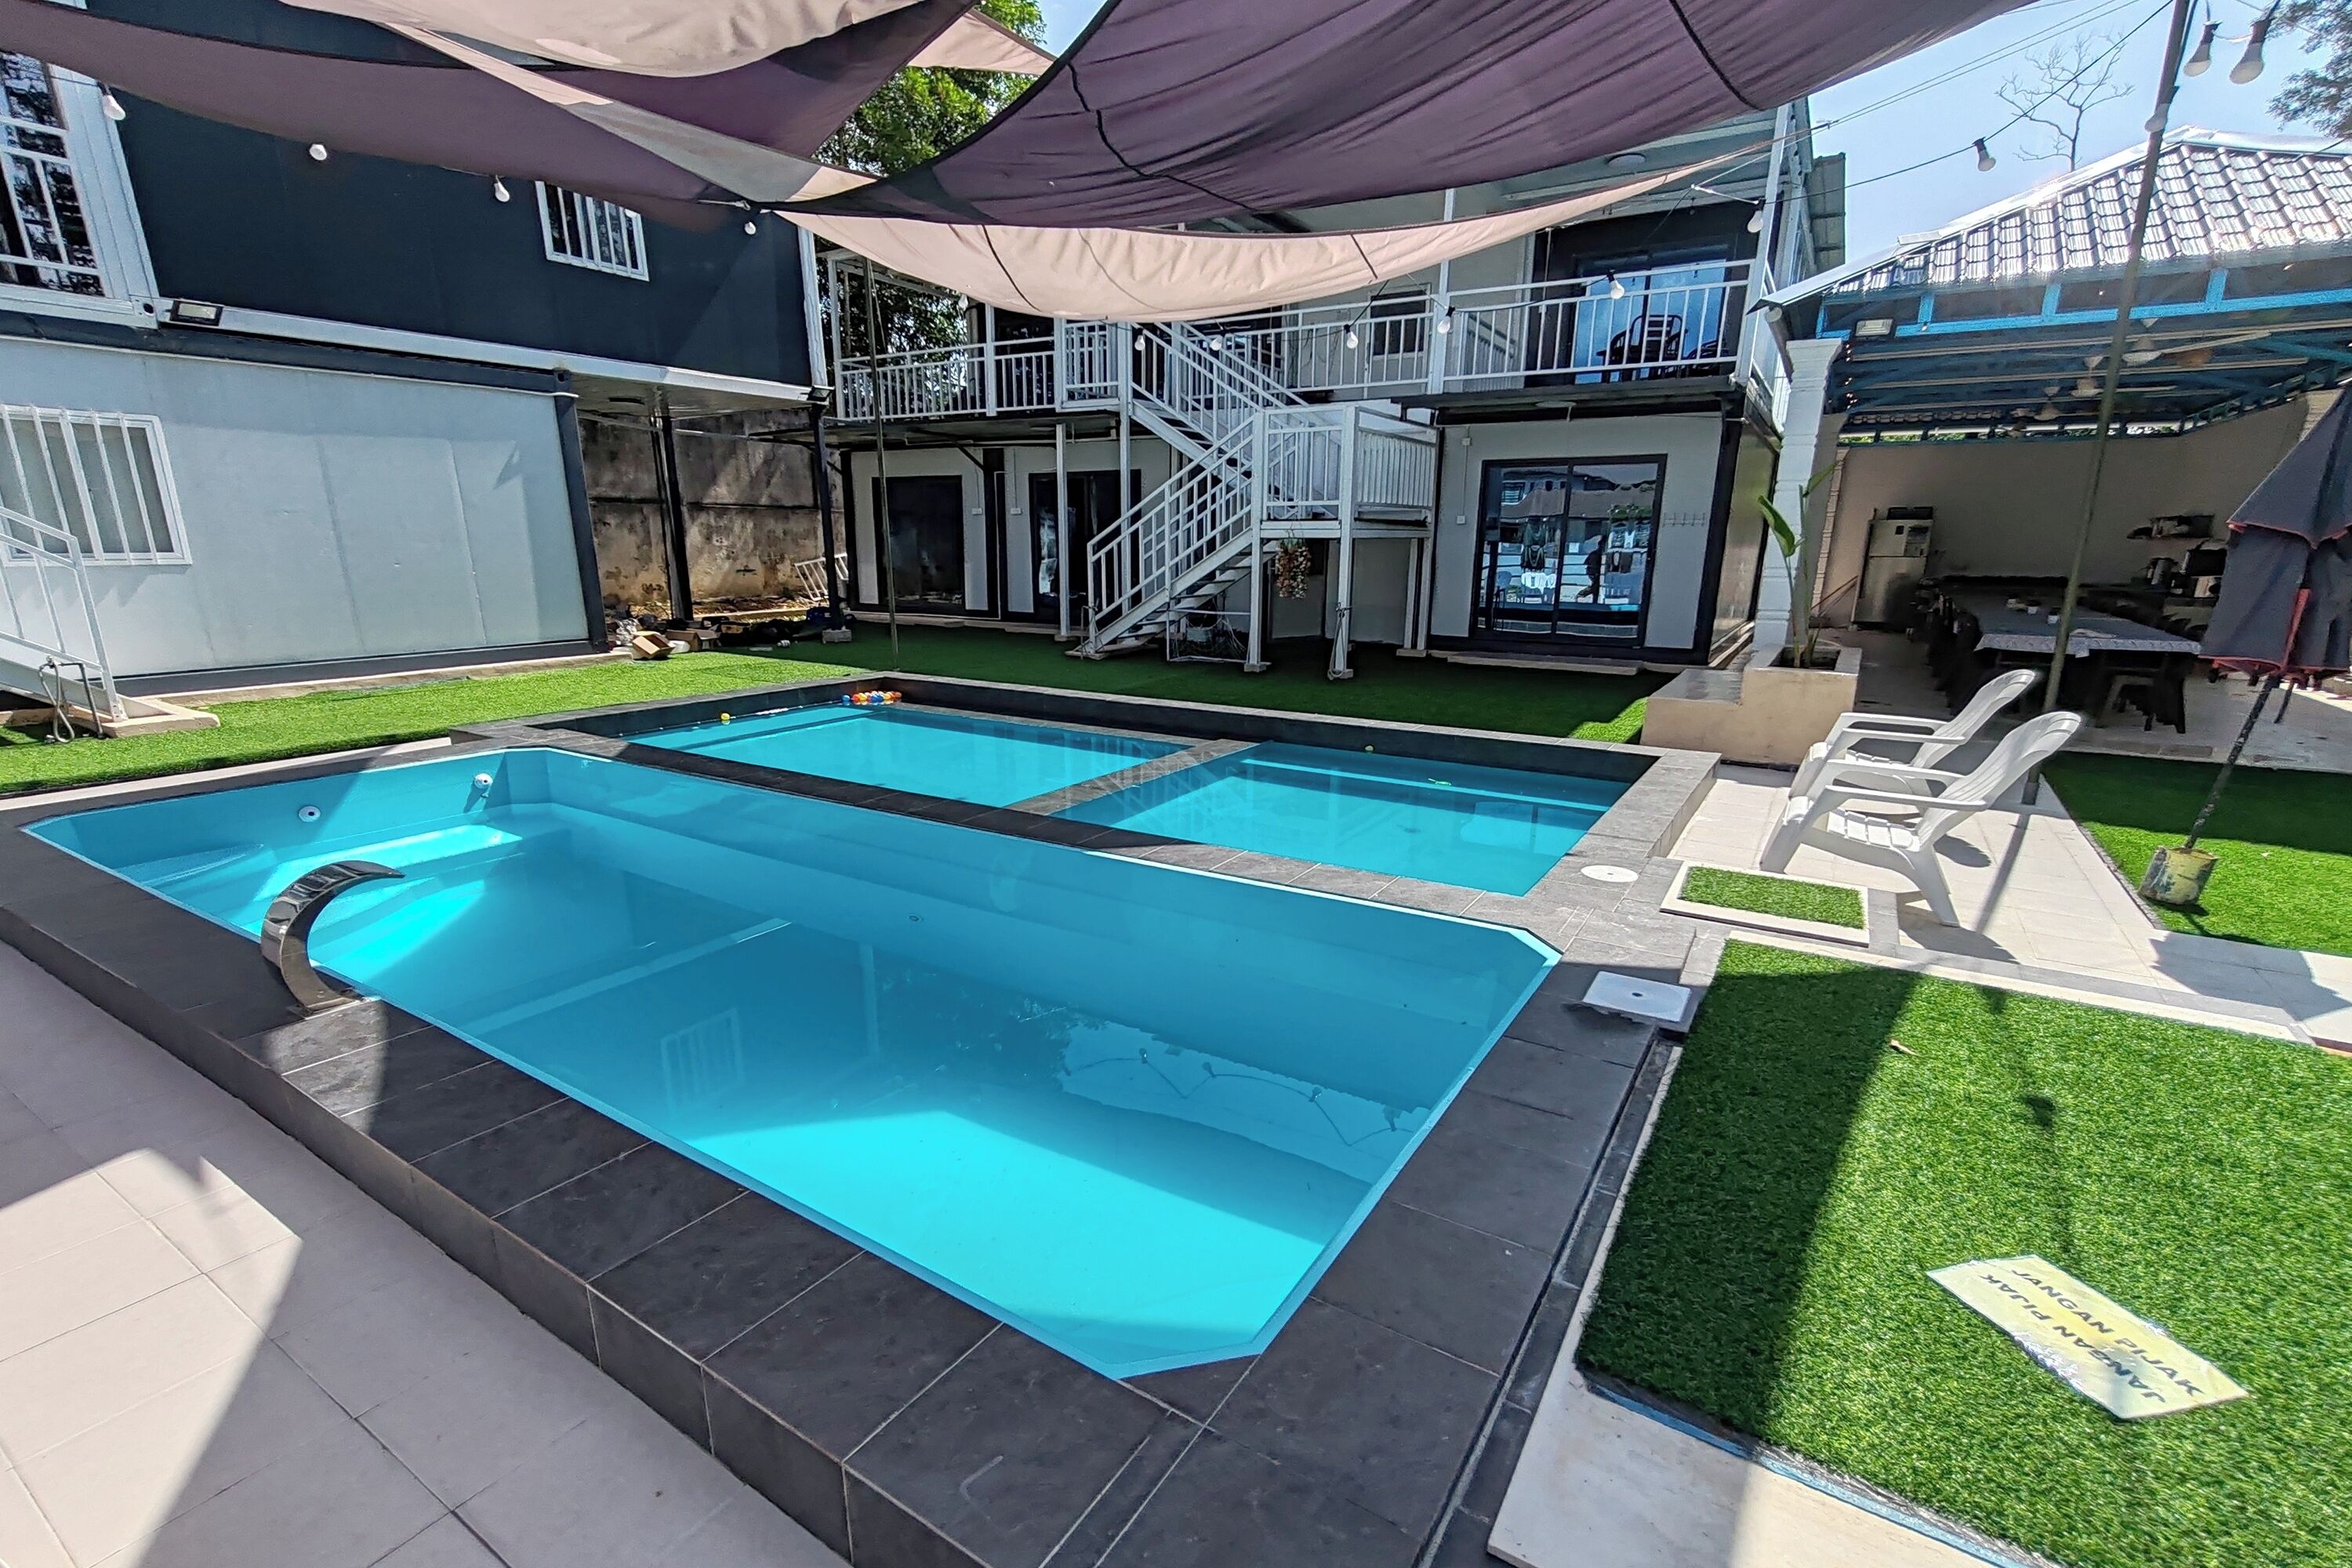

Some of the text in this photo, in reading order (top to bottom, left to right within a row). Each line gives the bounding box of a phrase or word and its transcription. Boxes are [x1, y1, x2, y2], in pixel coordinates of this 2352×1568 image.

[1979, 1274, 2166, 1403] JANGAN PIJAK
[2011, 1269, 2204, 1397] JANGAN PIJAK
